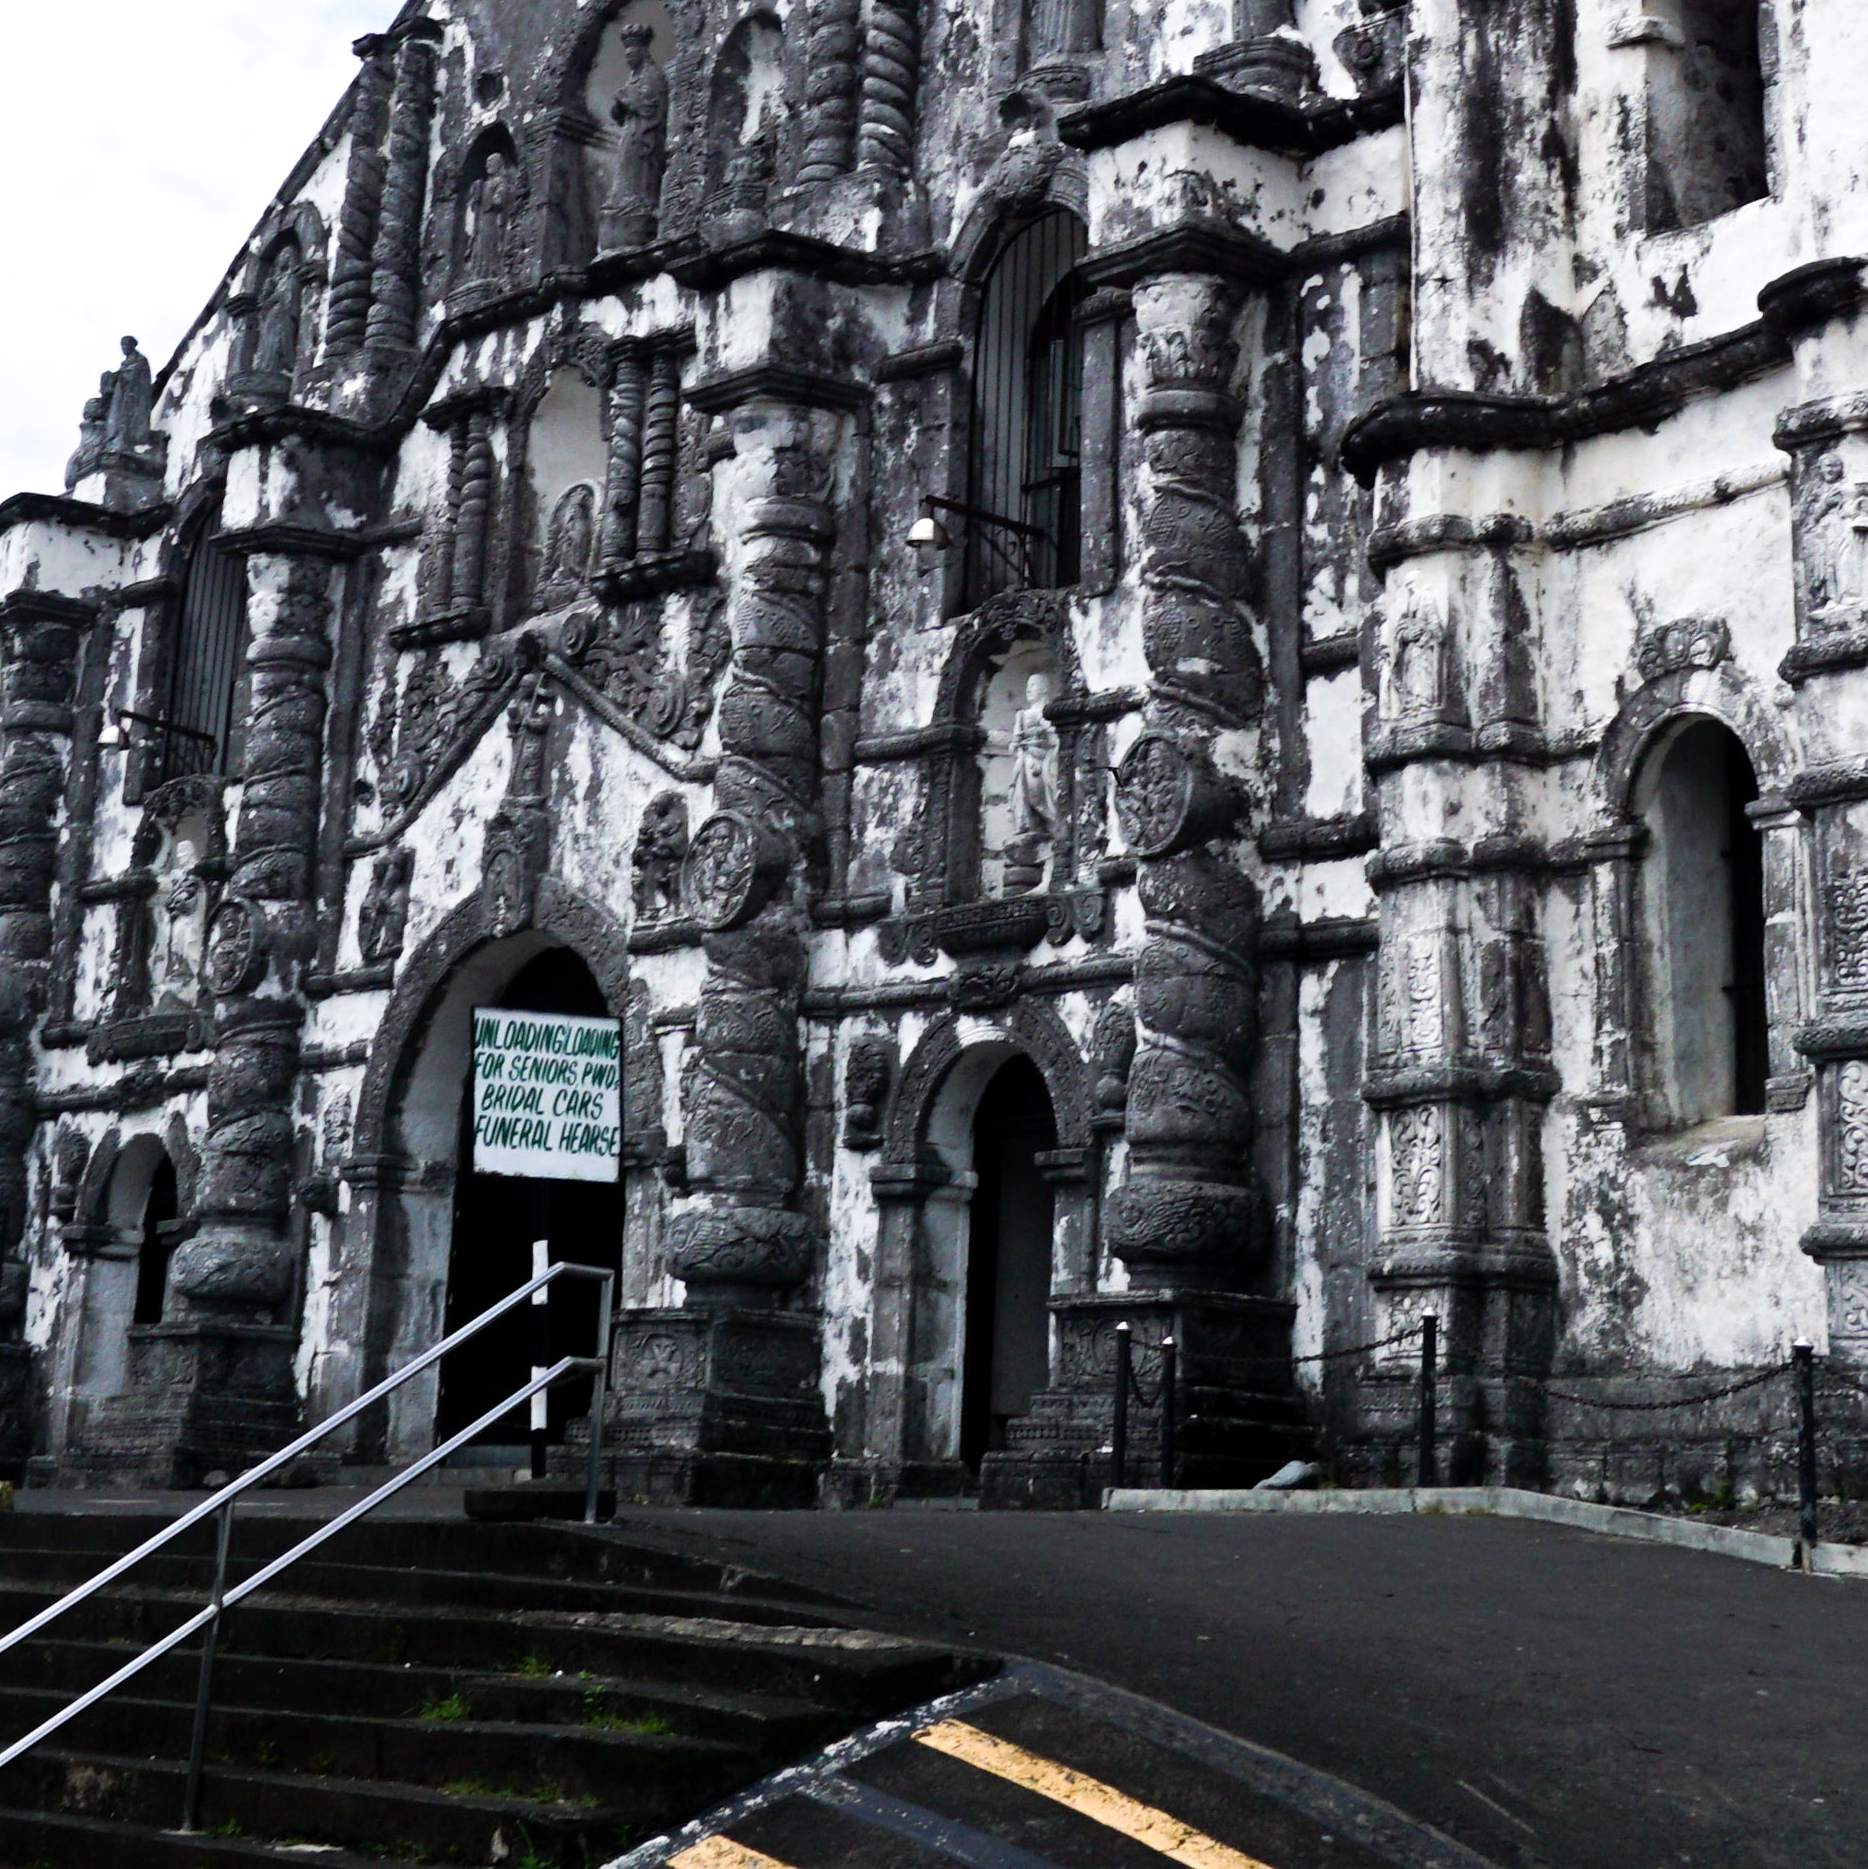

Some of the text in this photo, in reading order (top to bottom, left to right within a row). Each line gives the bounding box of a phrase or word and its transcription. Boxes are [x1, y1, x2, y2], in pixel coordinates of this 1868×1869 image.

[474, 1051, 505, 1080] FOR
[508, 1054, 578, 1086] SENIORS
[481, 1083, 604, 1120] BRIDAL CARS
[474, 1114, 620, 1158] FUNERAL HEARSE
